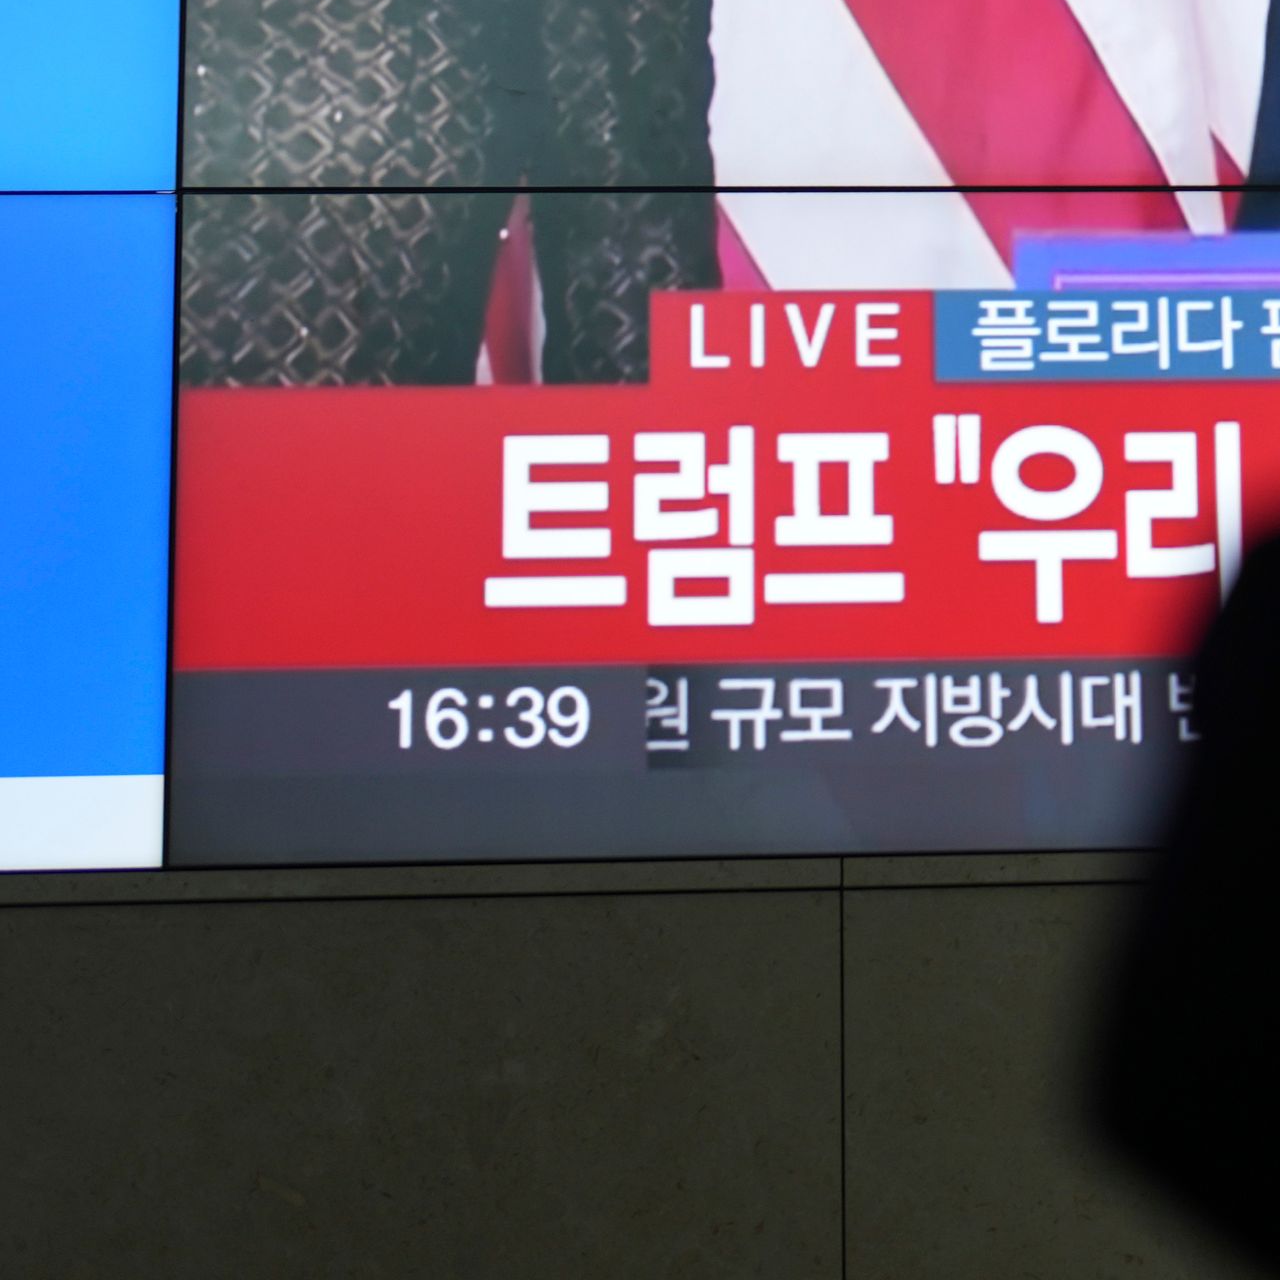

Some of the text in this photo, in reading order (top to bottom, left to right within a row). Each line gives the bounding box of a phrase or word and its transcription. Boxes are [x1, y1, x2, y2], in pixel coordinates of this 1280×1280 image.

[690, 303, 900, 368] LIVE
[971, 297, 1243, 370] 플로리다
[484, 424, 905, 627] 트럼프
[932, 413, 1242, 624] "우리
[388, 685, 592, 750] 16:39
[710, 676, 853, 749] 규모
[870, 671, 1144, 746] 지방시대
